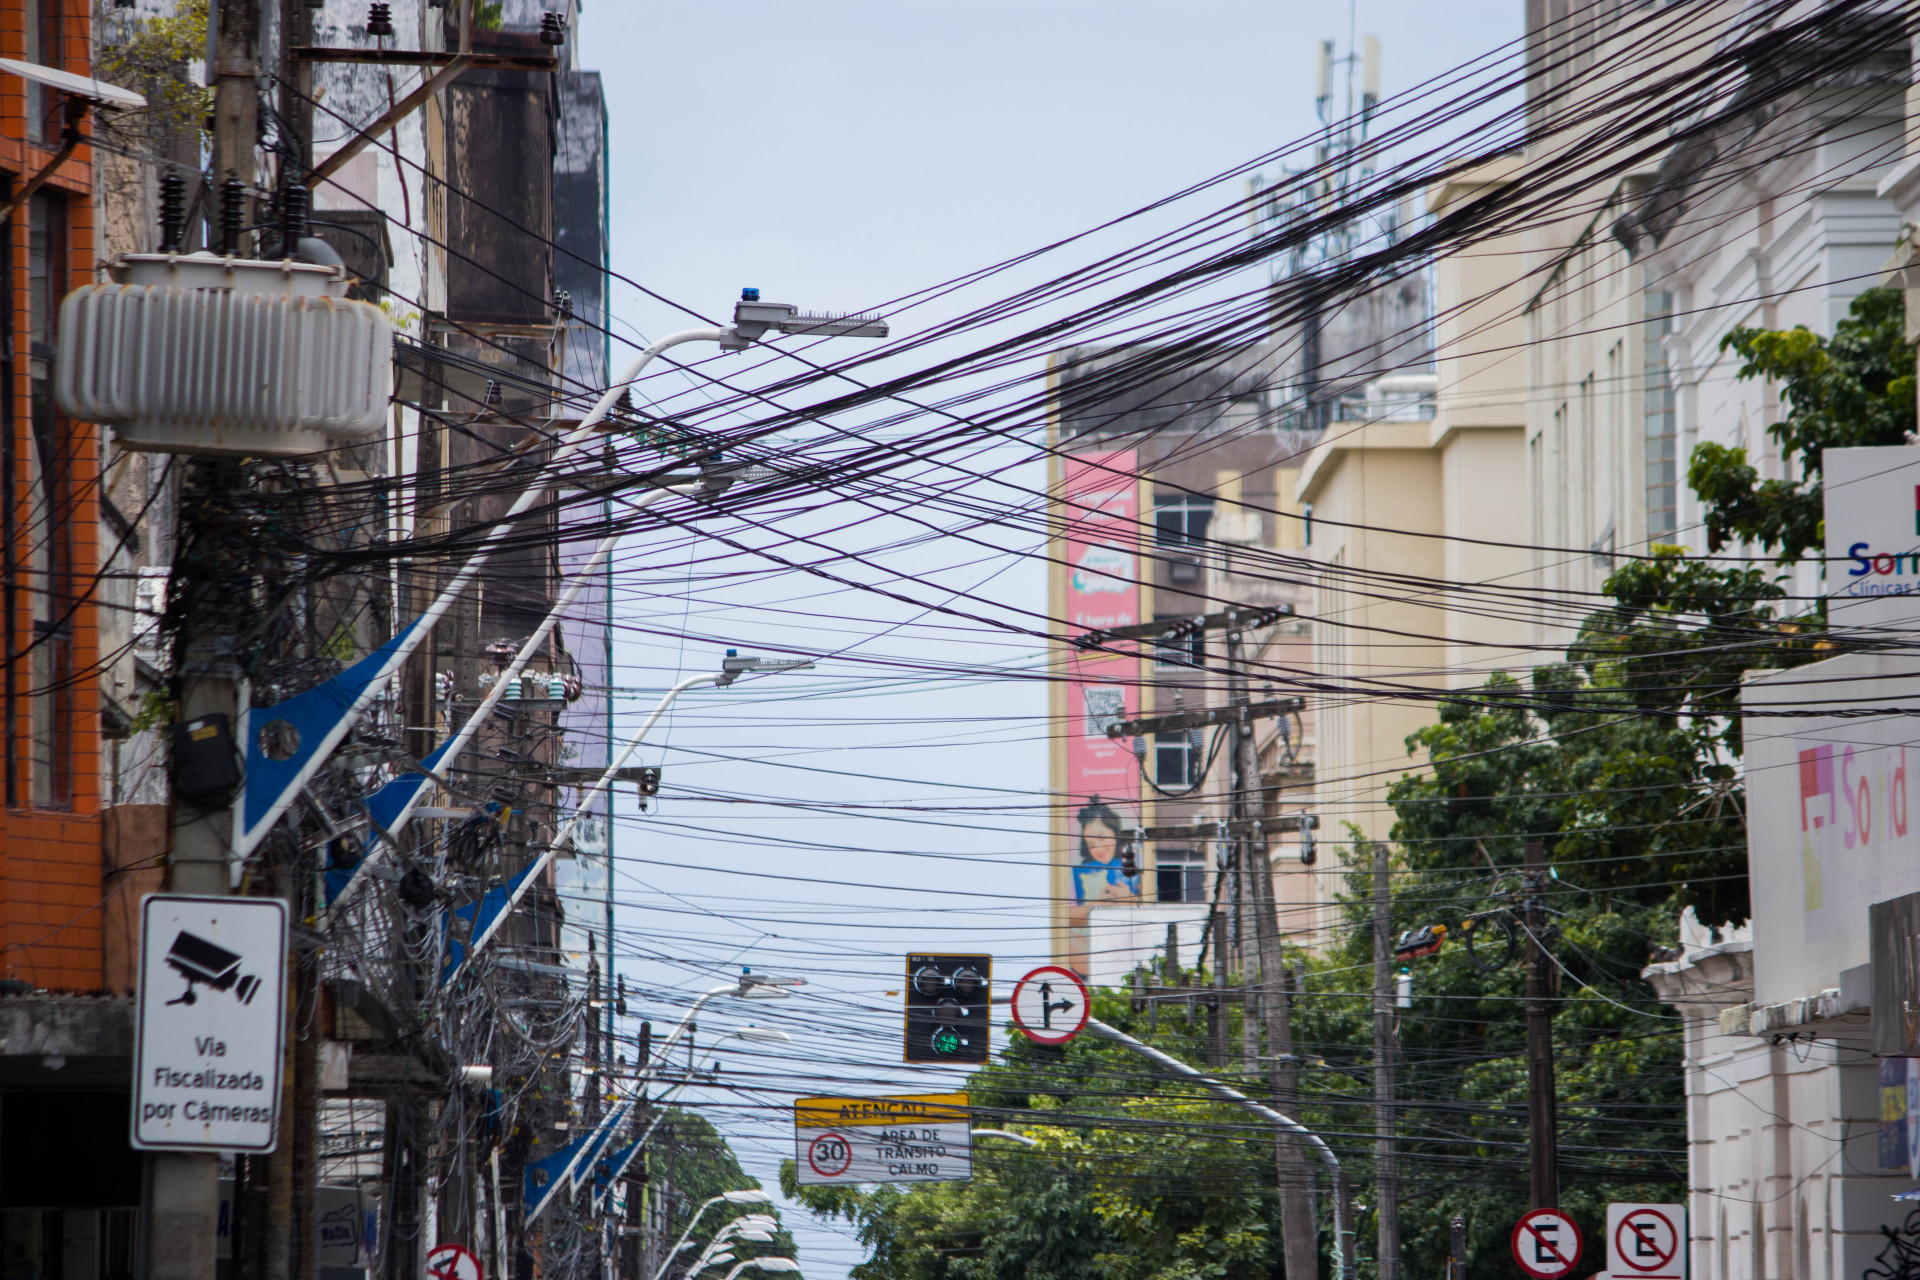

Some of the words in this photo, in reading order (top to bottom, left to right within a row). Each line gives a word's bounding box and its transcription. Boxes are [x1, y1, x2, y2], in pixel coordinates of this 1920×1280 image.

[1848, 579, 1911, 596] Clínicas
[195, 1036, 226, 1057] Via
[155, 1067, 264, 1090] Fiscalizada
[143, 1102, 176, 1123] por
[922, 1129, 940, 1142] DE
[816, 1143, 844, 1161] 30
[889, 1163, 939, 1175] CALMO
[1535, 1224, 1559, 1263] E
[1636, 1223, 1657, 1257] E
